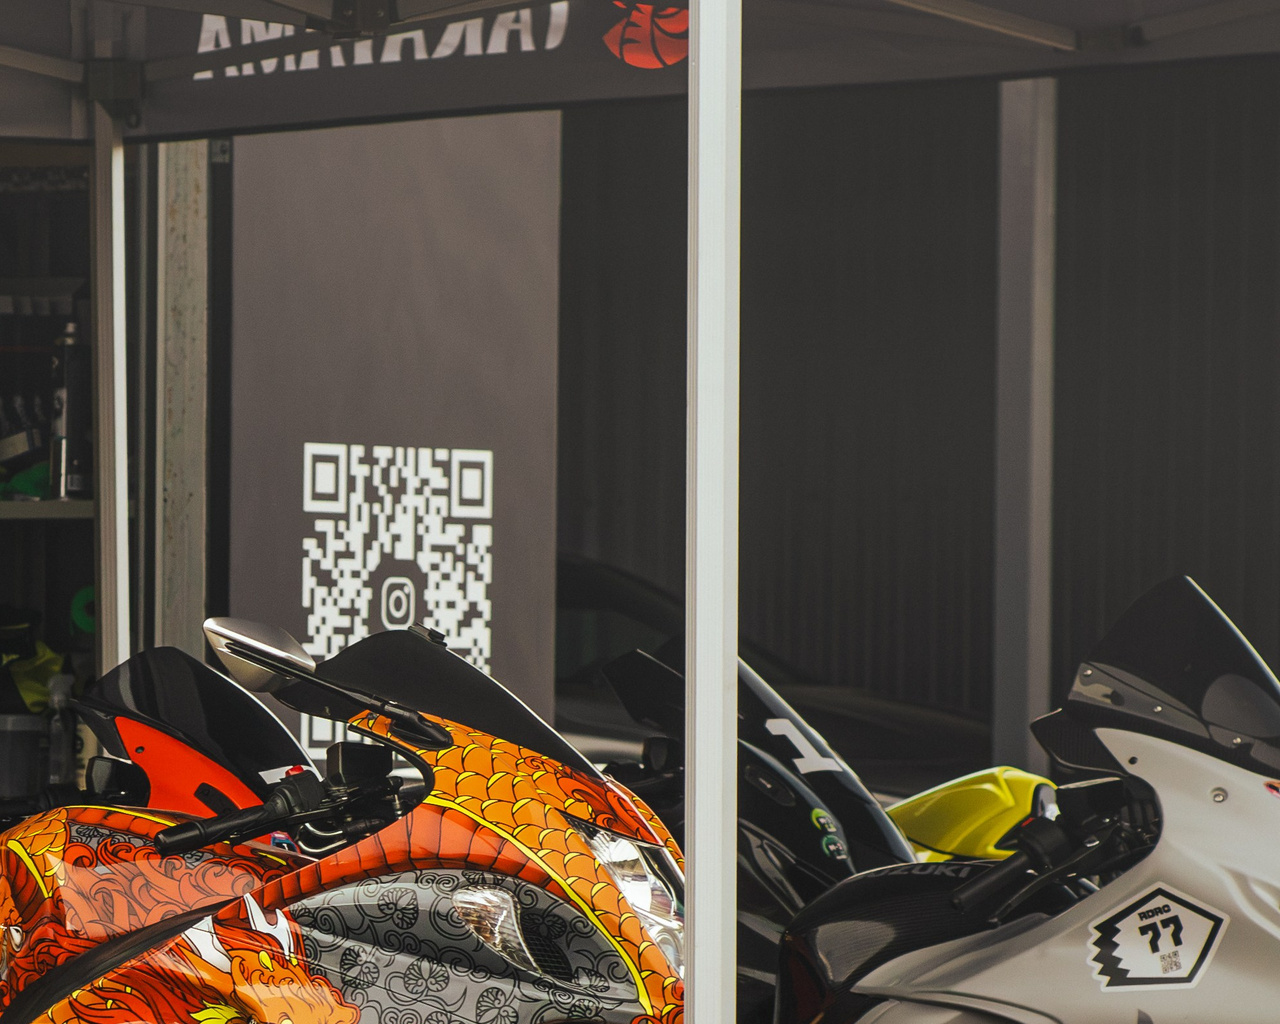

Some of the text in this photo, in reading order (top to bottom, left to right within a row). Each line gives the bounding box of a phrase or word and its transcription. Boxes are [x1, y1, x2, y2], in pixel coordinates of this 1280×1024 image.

[765, 718, 843, 774] 1
[866, 864, 972, 878] UZUKI
[1138, 915, 1183, 954] 77
